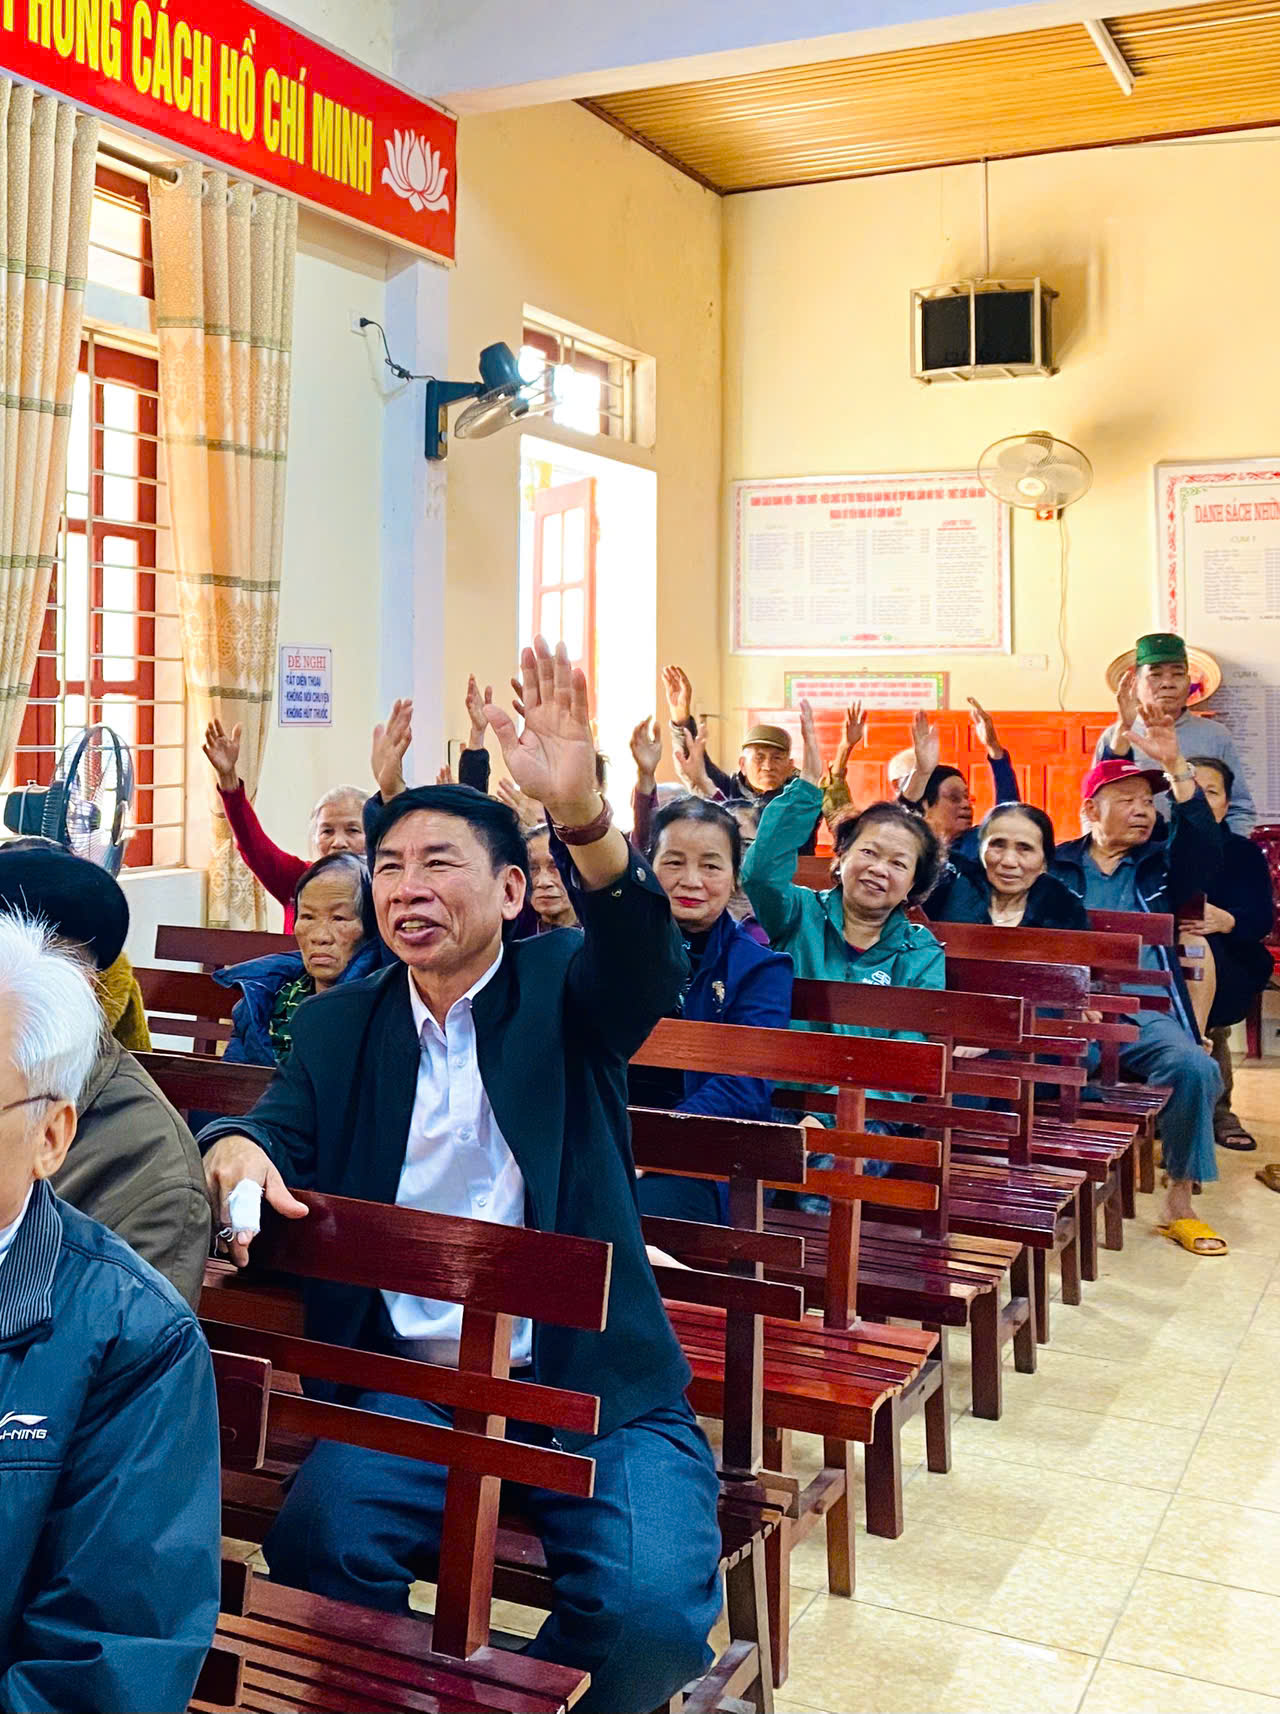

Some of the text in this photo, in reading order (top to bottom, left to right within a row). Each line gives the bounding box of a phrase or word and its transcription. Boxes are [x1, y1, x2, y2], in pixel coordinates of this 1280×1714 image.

[131, 0, 213, 123] CÁCH
[220, 28, 257, 142] HỒ
[263, 66, 307, 165] CHÍ
[312, 91, 373, 196] MINH
